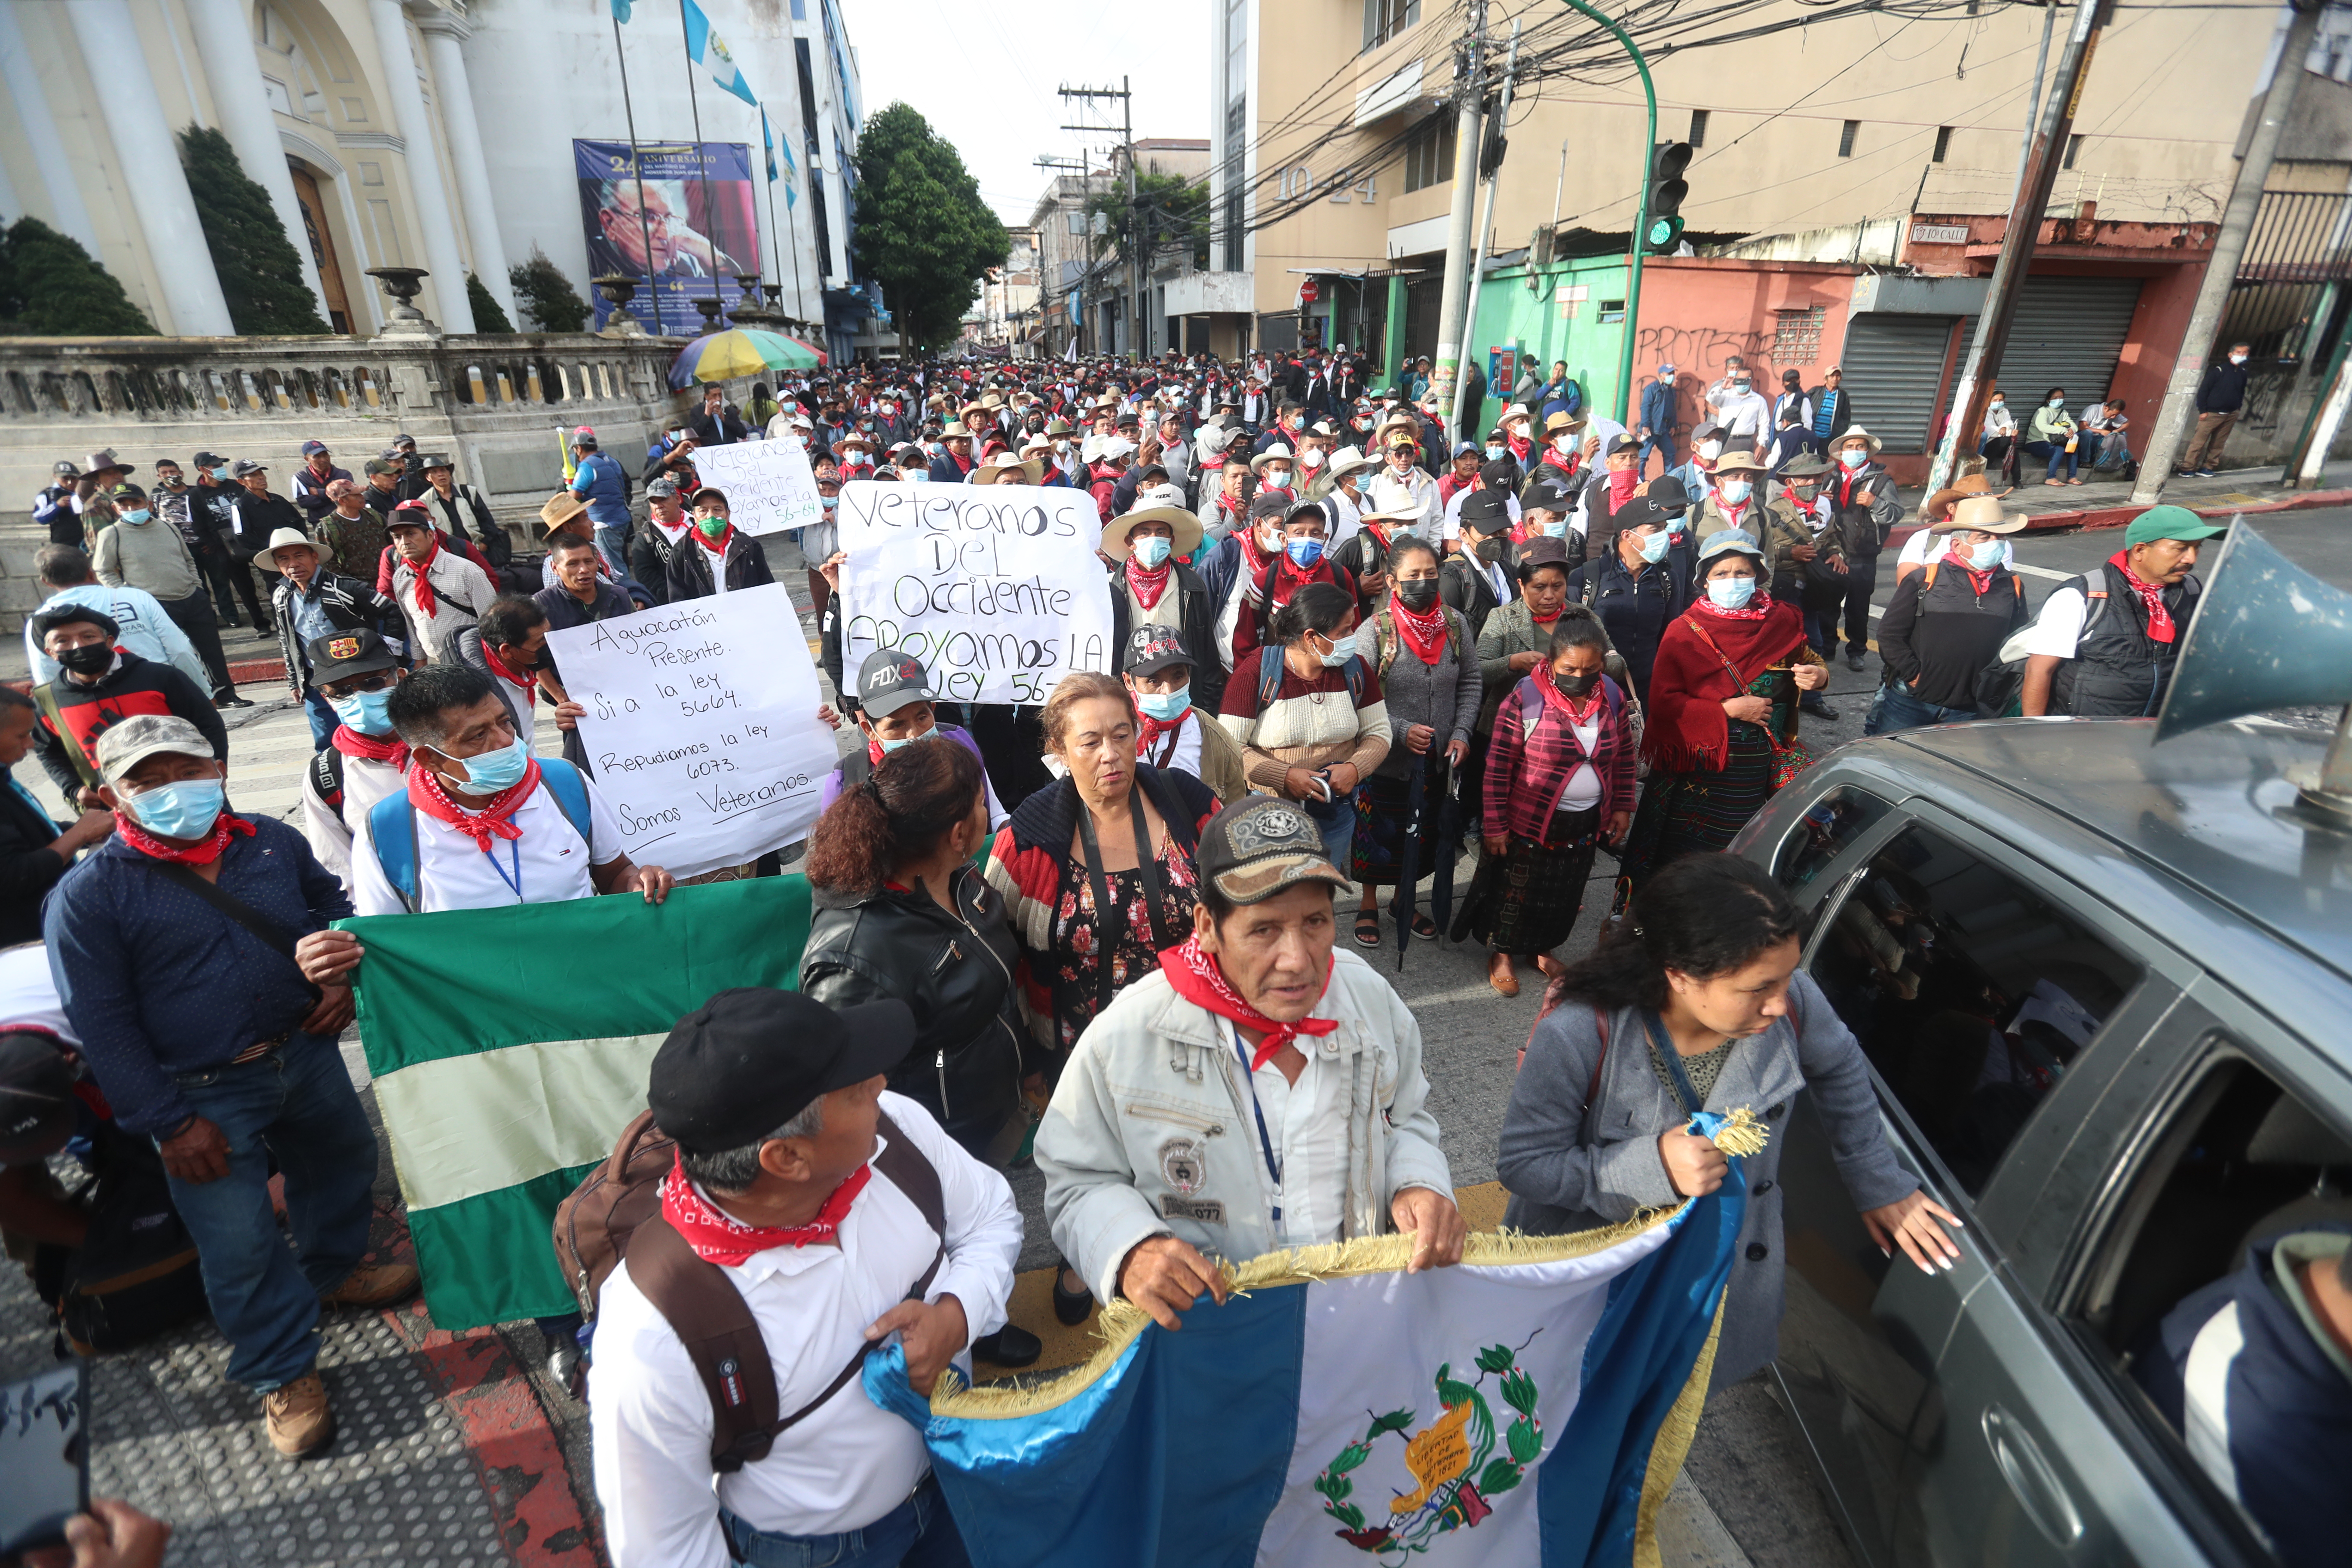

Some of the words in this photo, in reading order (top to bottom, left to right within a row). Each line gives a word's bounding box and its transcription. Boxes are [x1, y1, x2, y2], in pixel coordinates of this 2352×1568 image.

[1273, 166, 1378, 204] 10-24
[1941, 230, 1964, 240] CALLE
[1638, 325, 1779, 379] PROTESTAR
[1636, 375, 1707, 410] PRA
[695, 440, 799, 469] Veteranos
[729, 495, 789, 514] oyamos
[775, 502, 816, 524] 56-64
[845, 489, 1075, 536] Veteranos
[894, 575, 1070, 617] Occidente
[591, 609, 716, 654] Aguacatán
[644, 641, 731, 668] Presente.
[1069, 634, 1102, 671] LA
[868, 663, 903, 689] FOX
[594, 692, 616, 720] Si
[625, 698, 640, 712] a
[655, 683, 678, 699] la
[690, 672, 721, 689] ley
[599, 742, 709, 774] Repudiamos
[720, 734, 738, 747] la
[745, 724, 768, 738] ley
[687, 759, 739, 779] 6073.
[696, 773, 812, 813] Veteranos.
[619, 804, 681, 836] Somos
[1195, 1209, 1220, 1220] 077
[1417, 1431, 1459, 1465] LIBERTAD
[1439, 1444, 1450, 1456] DE
[1439, 1460, 1456, 1477] 1821
